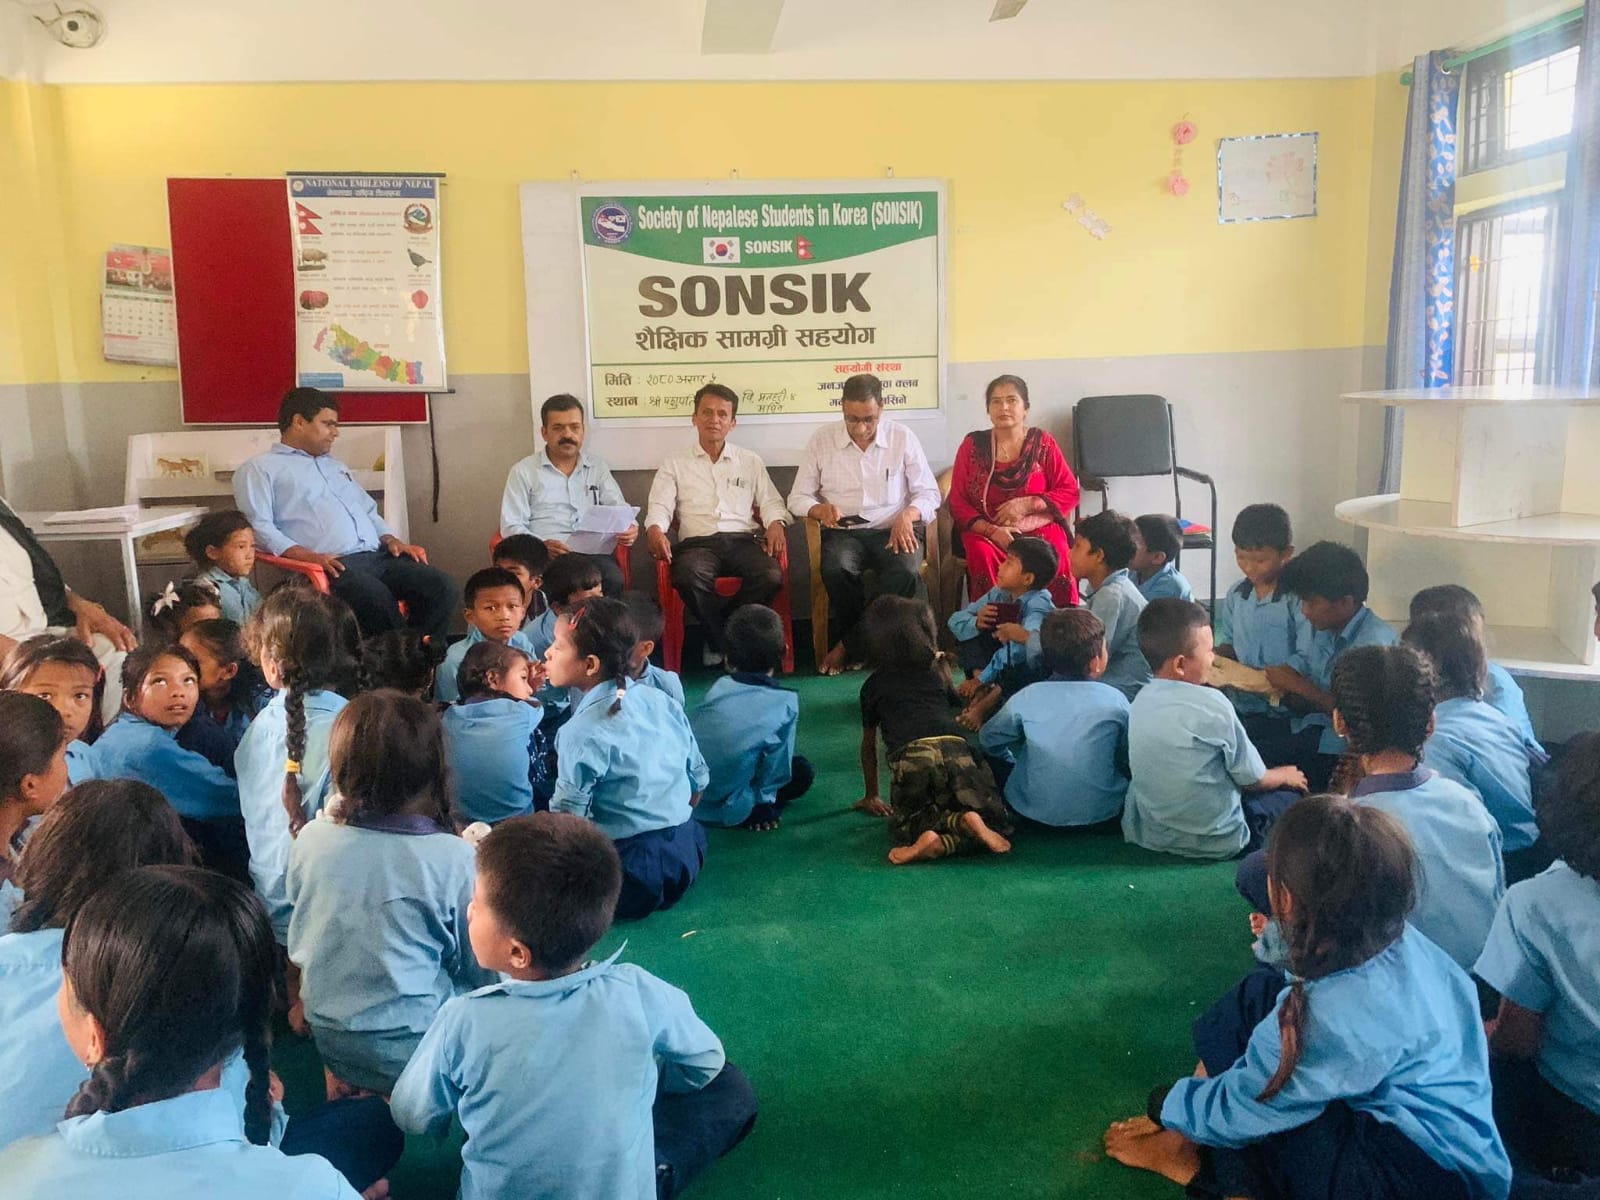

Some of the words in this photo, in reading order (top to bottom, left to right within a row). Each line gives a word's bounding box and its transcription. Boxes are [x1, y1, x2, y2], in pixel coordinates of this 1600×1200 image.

[305, 179, 348, 188] NATIONAL
[350, 179, 391, 188] EMBLEMS
[392, 179, 403, 188] OF
[405, 180, 433, 189] NEPAL
[638, 204, 683, 234] Society
[686, 204, 699, 229] of
[702, 204, 759, 233] Nepalese
[761, 203, 815, 228] Students
[817, 203, 829, 227] in
[832, 202, 868, 227] Korea
[871, 200, 923, 232] (SONSIK)
[744, 239, 793, 254] SONSIK
[638, 272, 872, 318] SONSIK
[635, 325, 708, 352] शैक्षिक
[716, 323, 788, 349] सामग्री
[795, 322, 876, 347] सहयोग
[833, 361, 872, 374] सहयोगी
[876, 362, 903, 372] संस्था
[605, 373, 633, 387] मिति
[606, 395, 638, 408] स्थान
